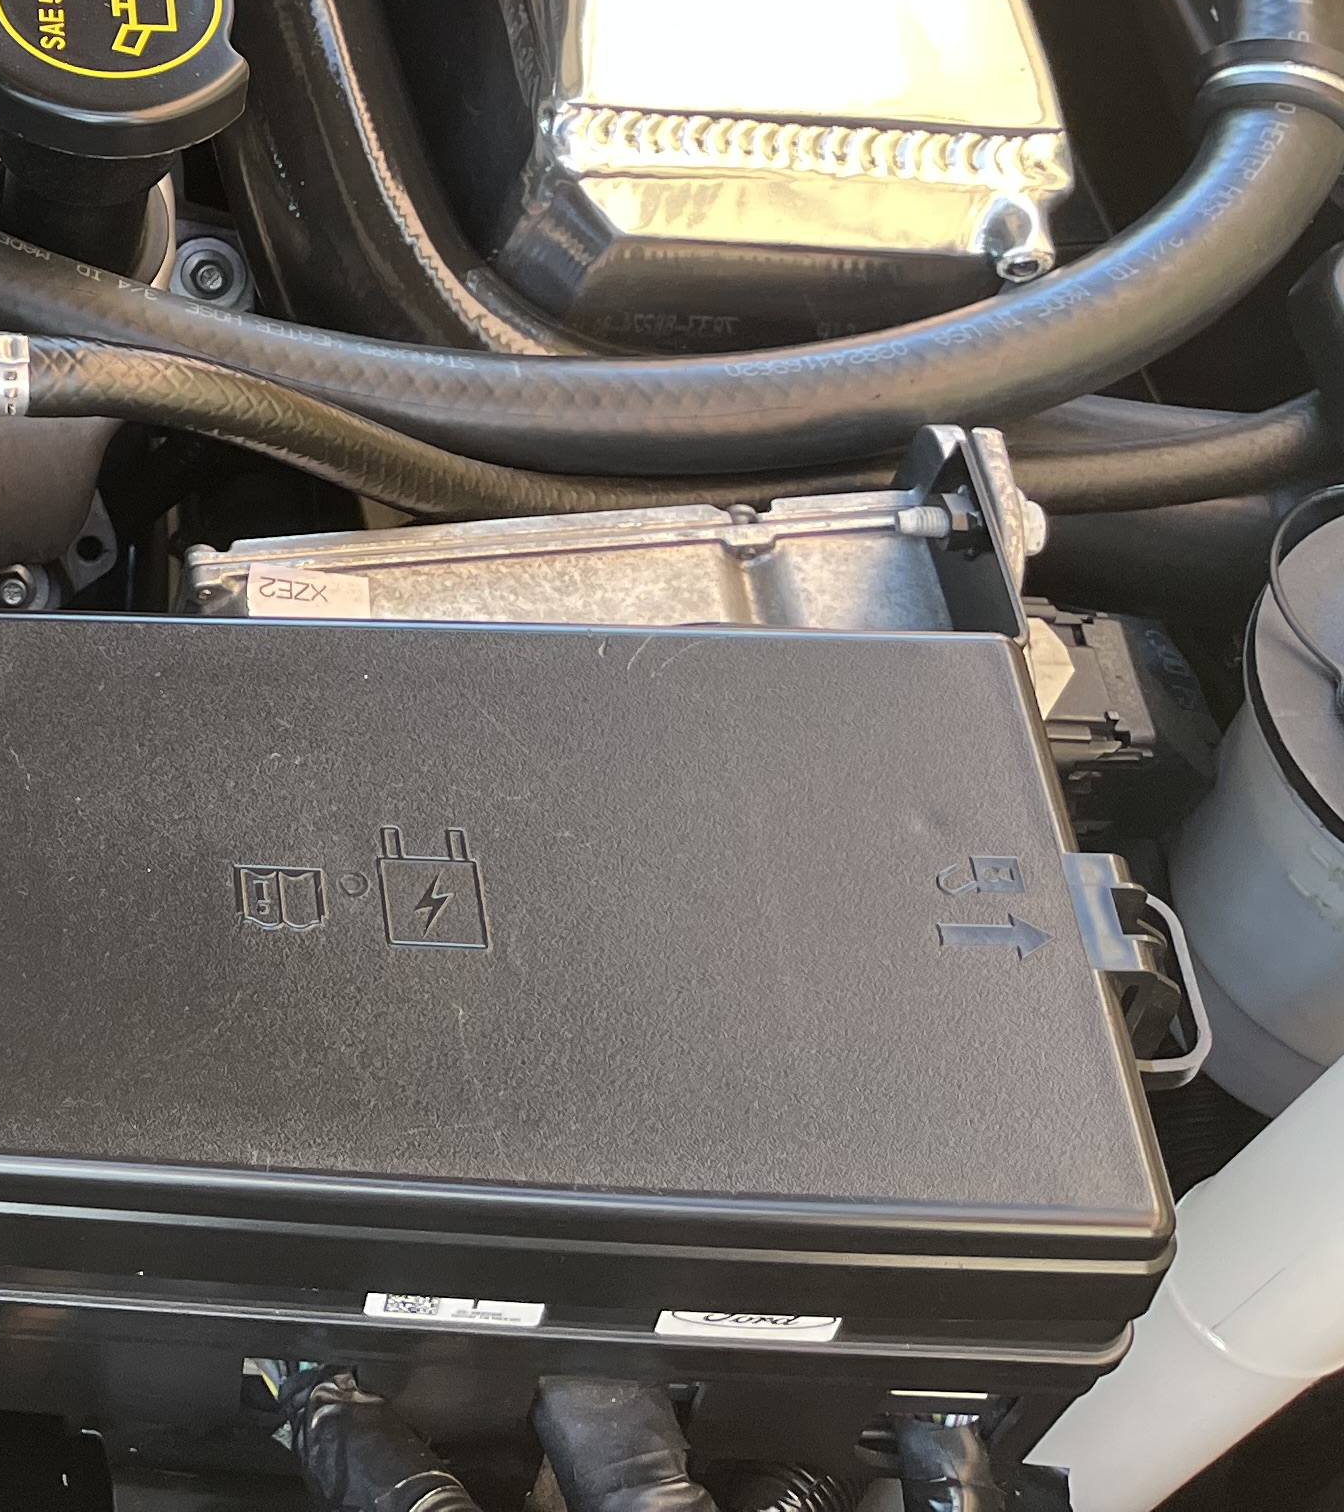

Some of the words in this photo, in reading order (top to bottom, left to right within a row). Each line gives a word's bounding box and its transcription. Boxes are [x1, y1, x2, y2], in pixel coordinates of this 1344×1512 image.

[39, 8, 66, 51] SAE
[75, 263, 100, 281] ID
[117, 278, 159, 301] 3/4
[1028, 278, 1090, 319] MADE
[184, 300, 241, 325] HOSE
[932, 319, 977, 346] USA
[258, 575, 329, 603] XZE2
